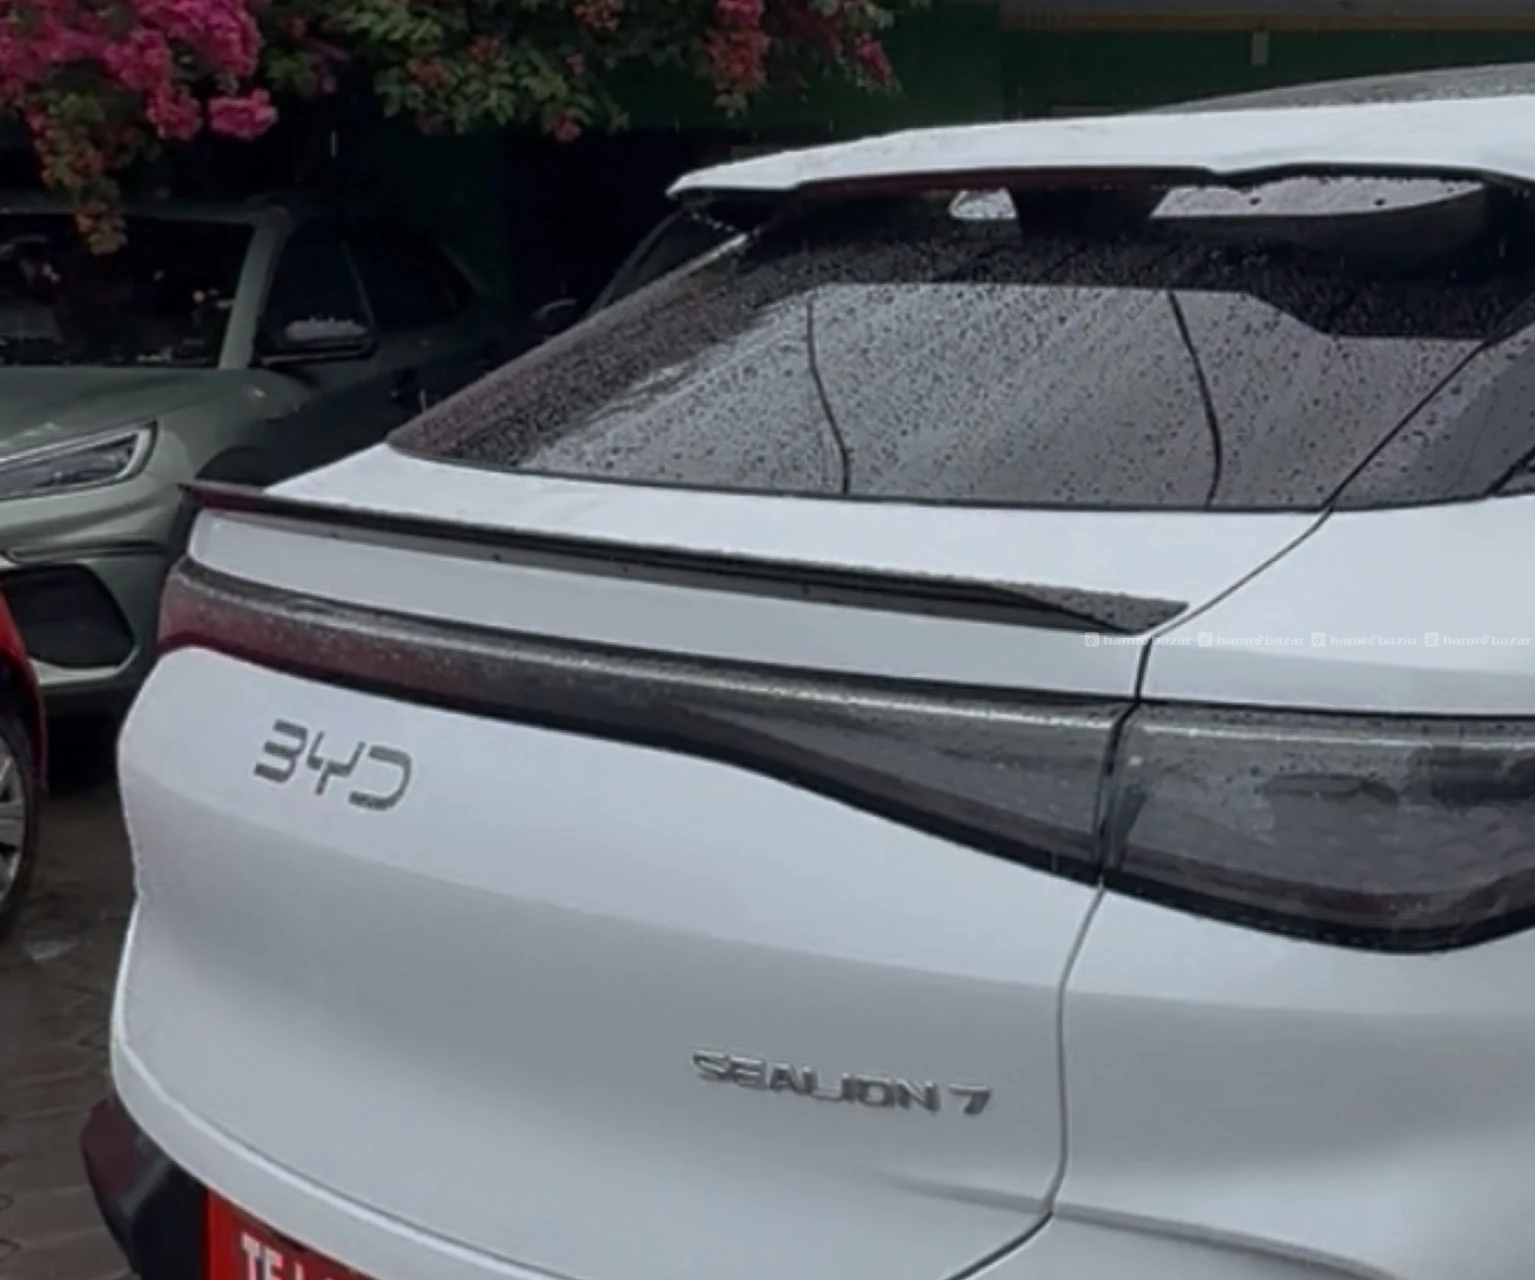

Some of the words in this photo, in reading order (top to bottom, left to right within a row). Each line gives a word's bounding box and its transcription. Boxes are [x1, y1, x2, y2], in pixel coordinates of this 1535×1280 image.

[254, 719, 412, 811] BYD
[692, 1050, 941, 1113] SEALION
[949, 1083, 992, 1116] 7
